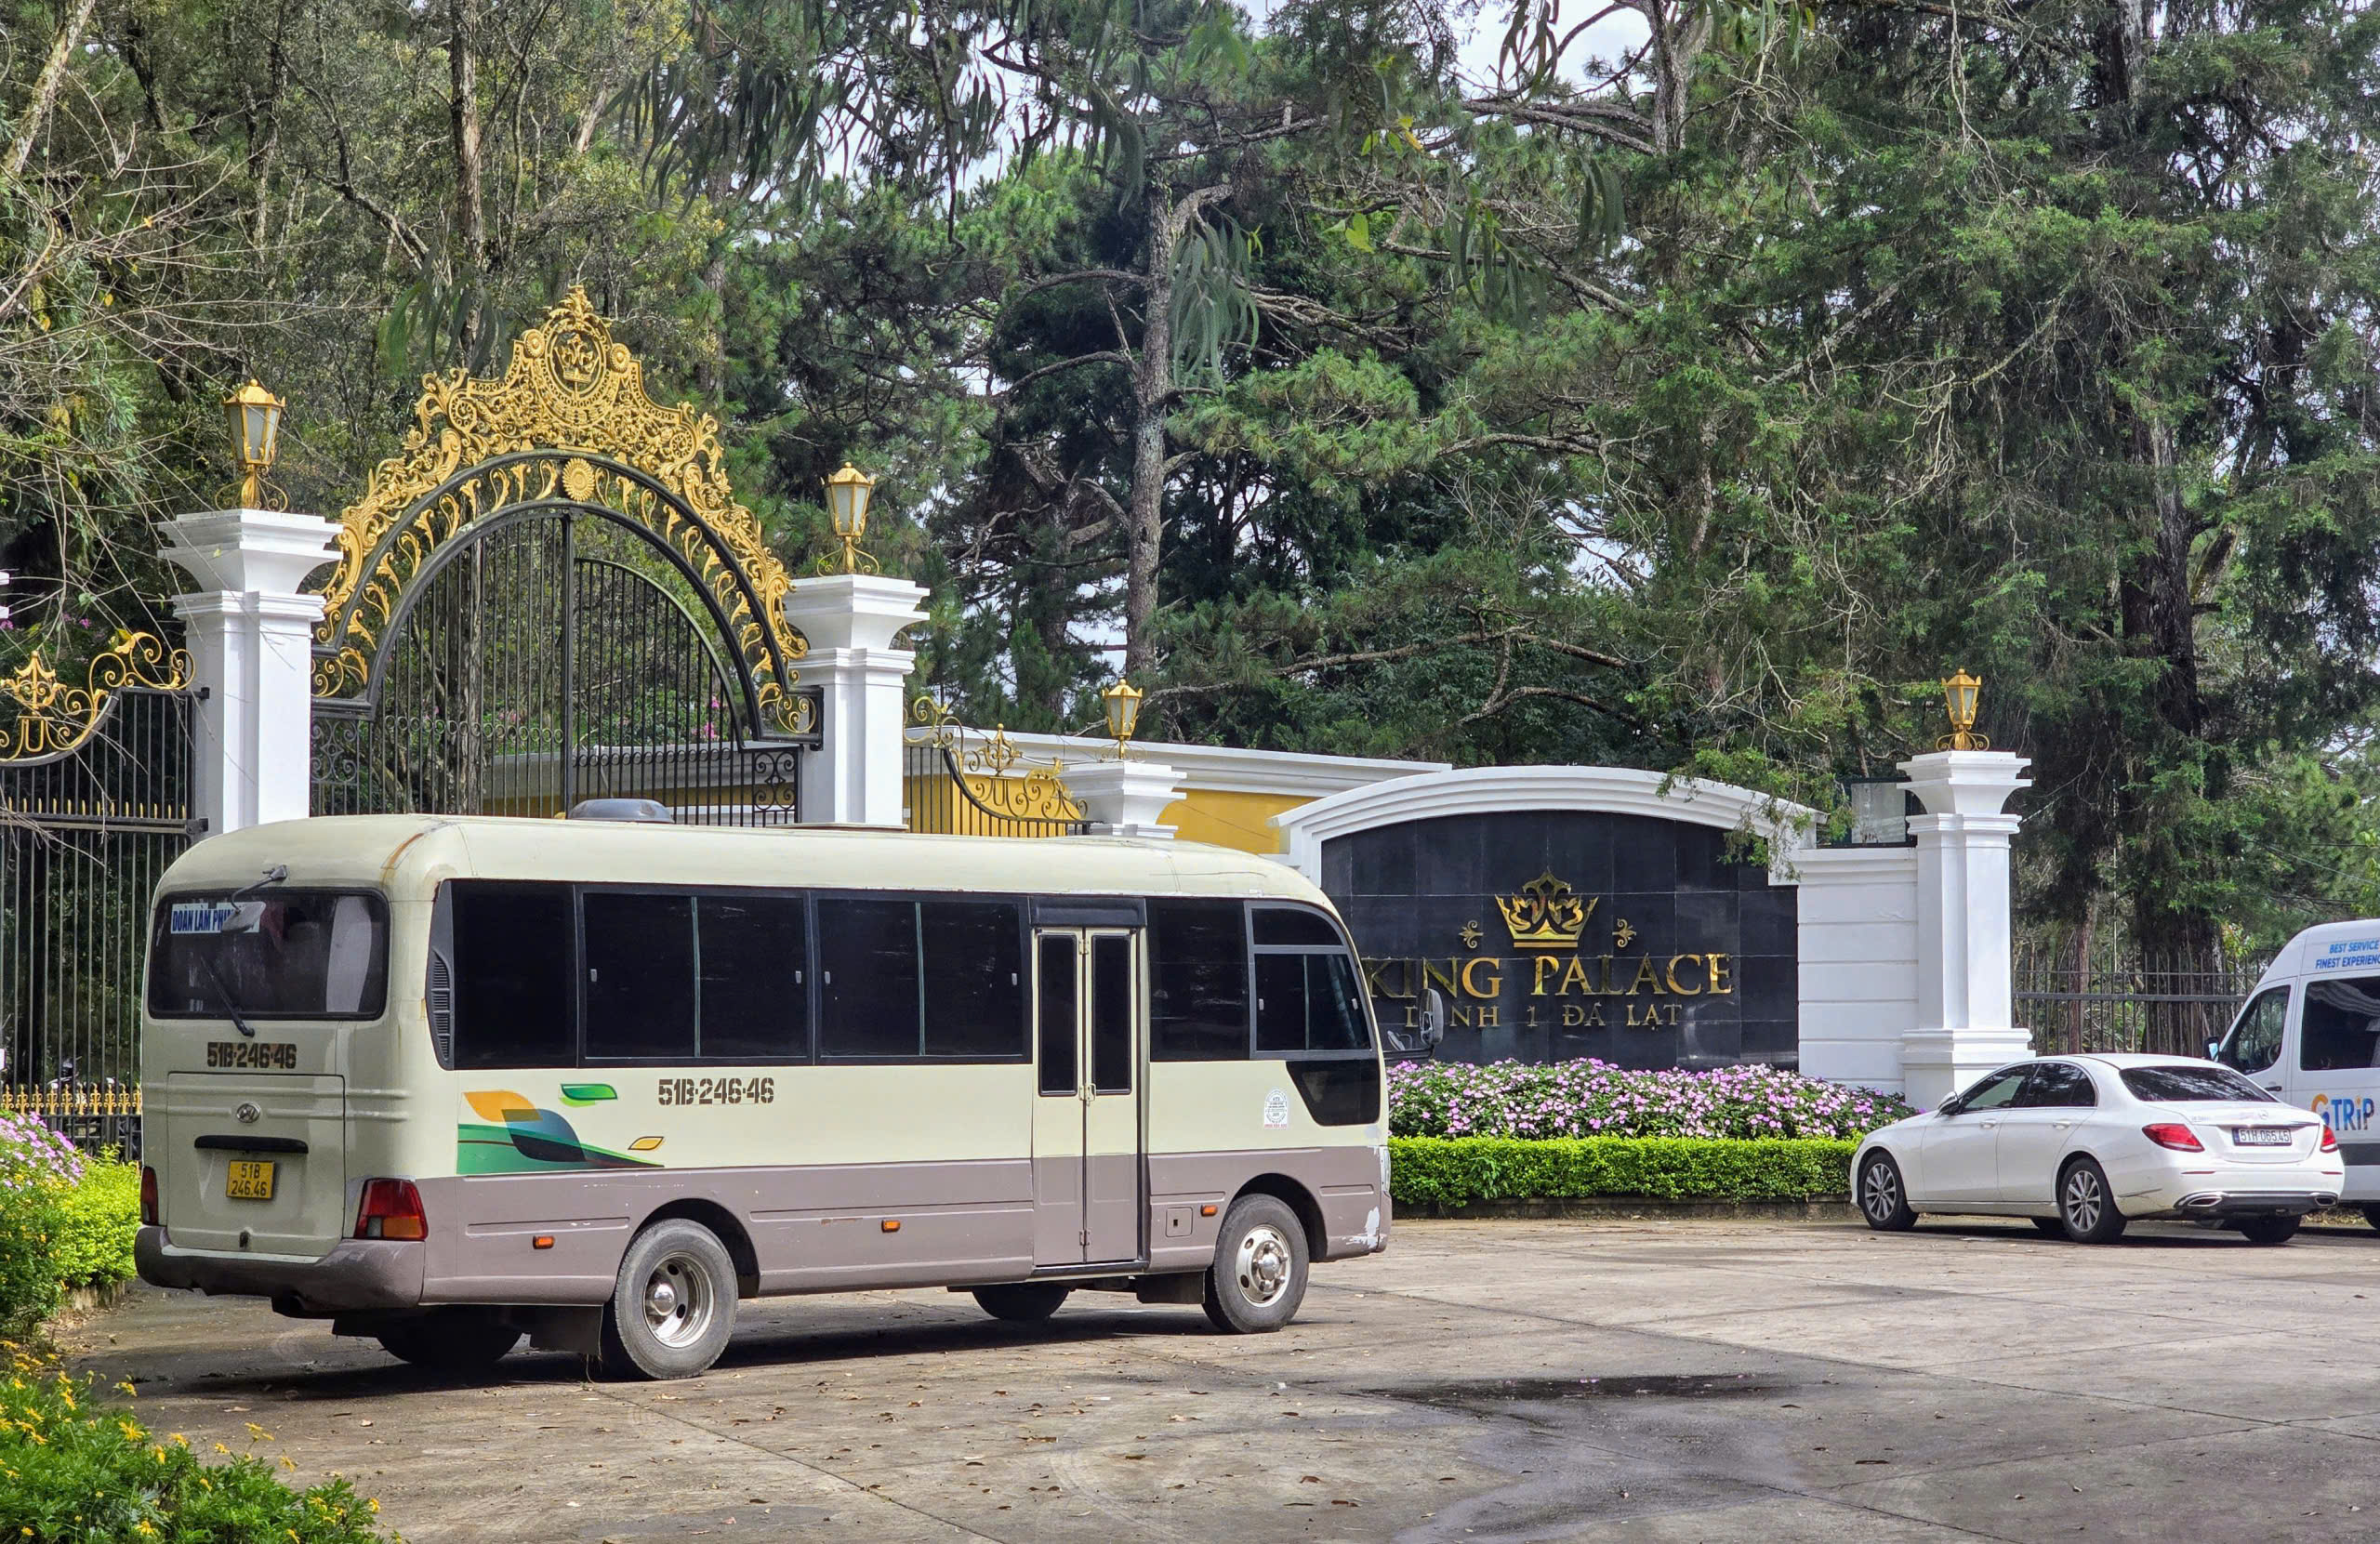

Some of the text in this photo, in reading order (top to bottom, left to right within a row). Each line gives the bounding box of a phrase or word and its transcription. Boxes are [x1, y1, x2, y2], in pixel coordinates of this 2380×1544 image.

[2329, 940, 2380, 954] BEST SERVICE
[2315, 957, 2341, 970] FINEST
[1361, 953, 1732, 998] KING PALACE
[1626, 1004, 1682, 1030] LẠT
[240, 1163, 260, 1179] 51B
[231, 1180, 268, 1197] 246.46
